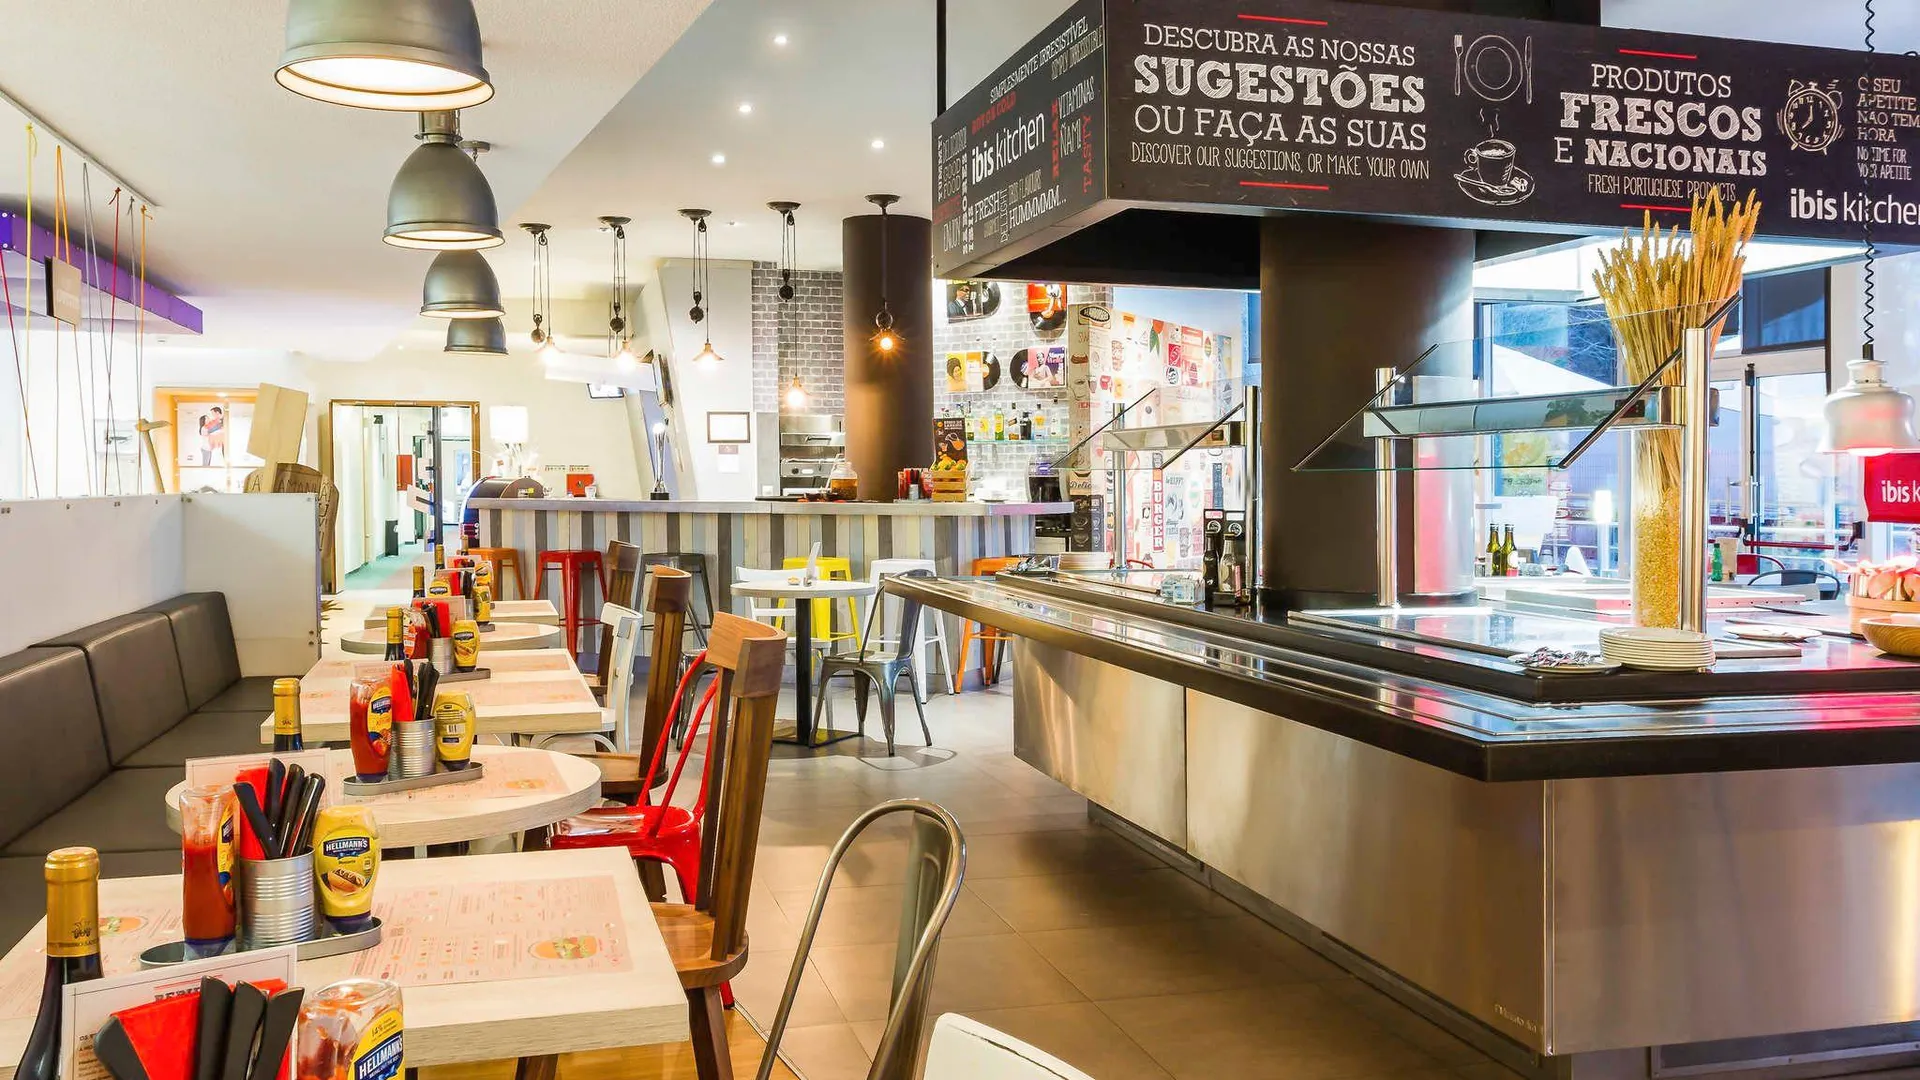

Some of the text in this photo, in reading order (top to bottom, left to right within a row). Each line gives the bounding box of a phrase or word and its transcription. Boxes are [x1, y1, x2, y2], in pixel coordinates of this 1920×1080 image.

[990, 16, 1089, 103] SIMPLESMENTE IRRESISTÍVEL
[1144, 24, 1415, 66] DESCUBRA AS NOSSAS
[1058, 75, 1095, 119] VITAMINAS
[1134, 54, 1425, 114] SUGESTÕES
[1591, 63, 1732, 98] PRODUTOS
[1874, 78, 1901, 93] SEU
[1134, 104, 1427, 151] OU FAÇA AS SUAS
[1560, 92, 1762, 142] FRESCOS
[972, 140, 995, 185] ibis
[996, 112, 1045, 171] kitchen
[1082, 113, 1092, 194] TASTY
[1131, 141, 1430, 179] DISCOVER OUR SUGGESTIONS, OR MAKE YOUR OWN
[1554, 137, 1767, 176] E NACIONAIS
[1892, 148, 1907, 164] FOR
[1588, 174, 1620, 194] FRESH
[1623, 176, 1684, 198] PORTUGUESE
[1880, 164, 1912, 181] APETITE
[974, 190, 1000, 223] FRESH
[1790, 188, 1837, 220] ibis
[1881, 480, 1910, 503] ibis
[1153, 480, 1163, 548] BURGER
[326, 838, 368, 851] HELLMANN'S
